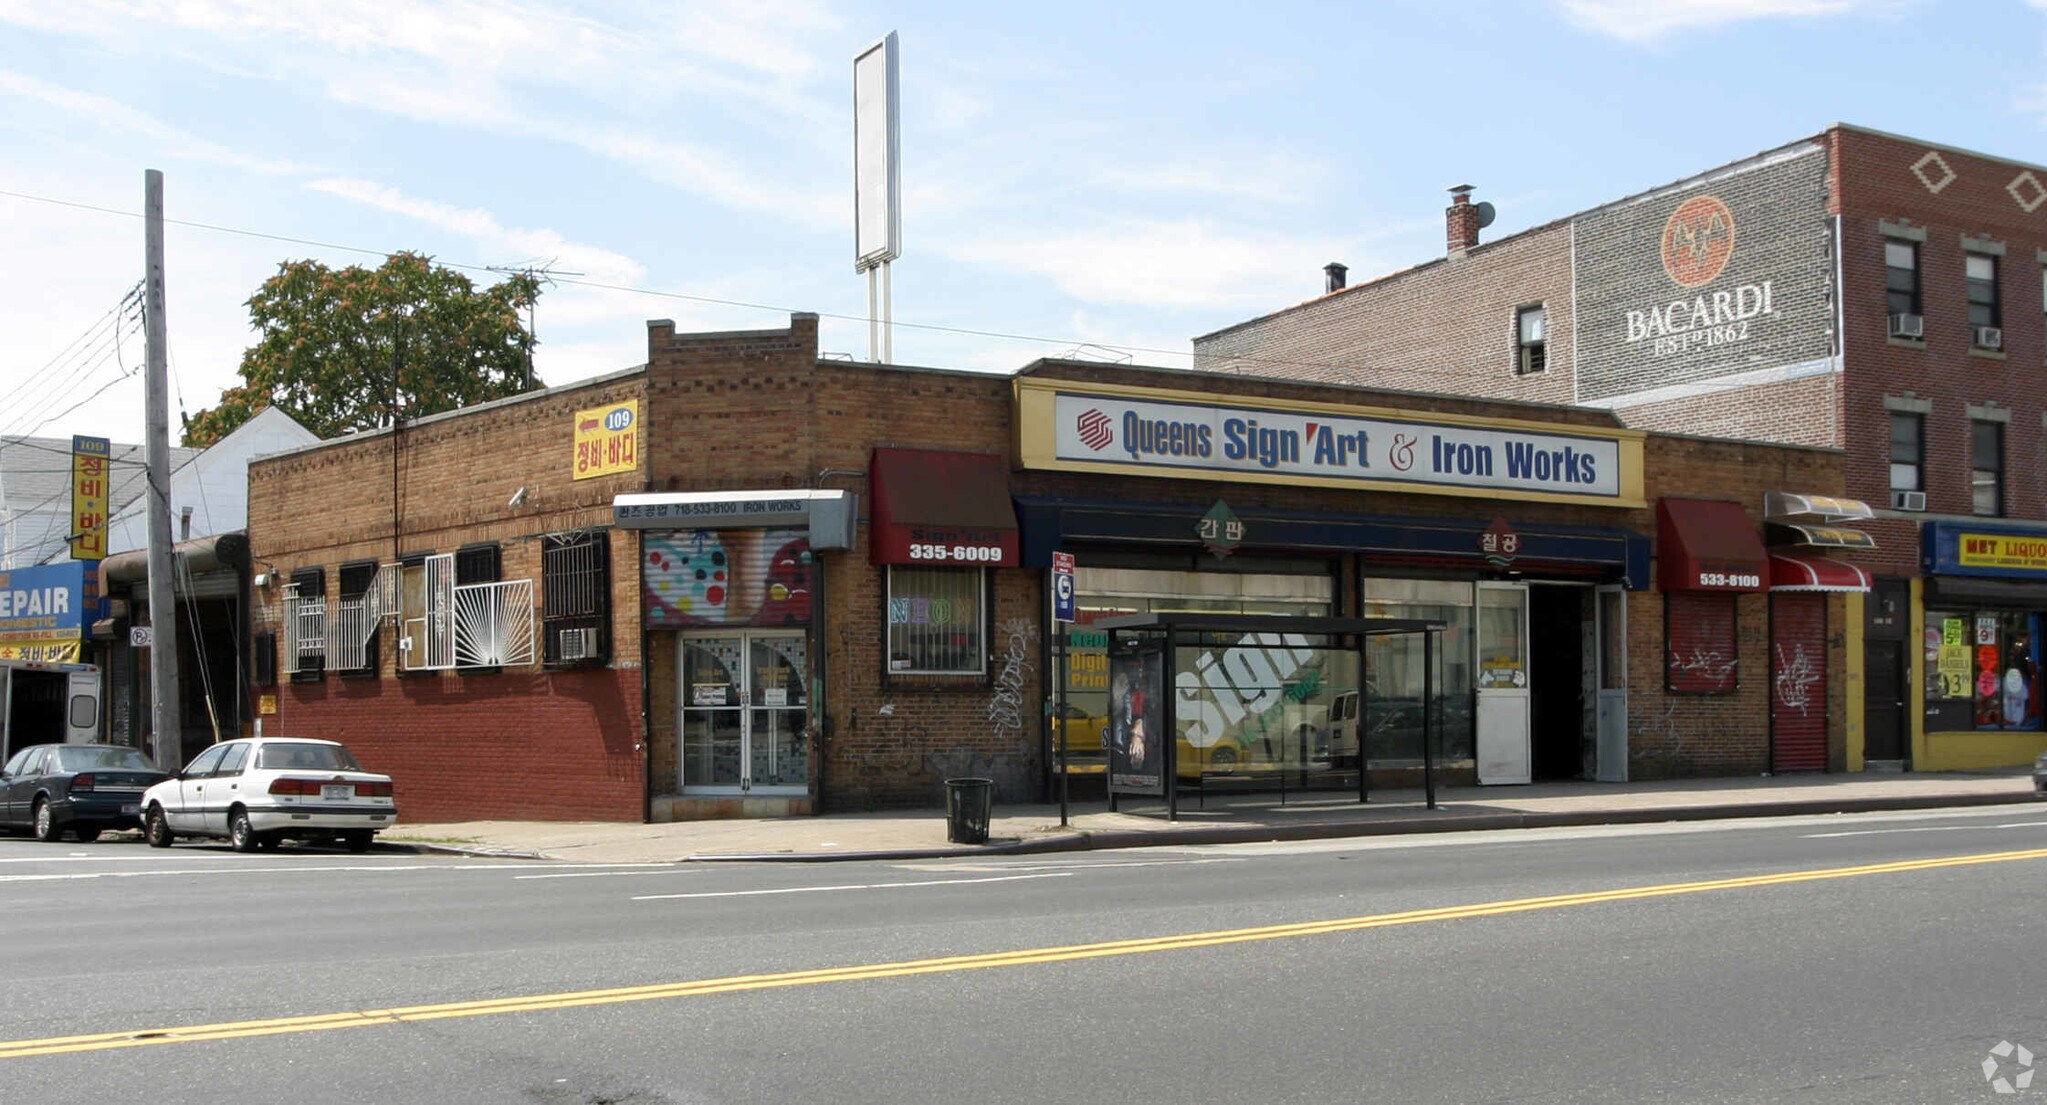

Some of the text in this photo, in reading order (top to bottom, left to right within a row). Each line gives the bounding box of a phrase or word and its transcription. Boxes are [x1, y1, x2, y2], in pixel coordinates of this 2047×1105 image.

[1626, 281, 1773, 342] BACARDI
[1706, 321, 1749, 347] 1862
[608, 410, 630, 429] 109
[80, 440, 105, 452] 109
[1122, 410, 1212, 460] Queens
[1223, 418, 1299, 468] Sign
[1389, 433, 1418, 471] &
[1432, 435, 1493, 476] Iron
[1505, 441, 1596, 484] Works
[674, 503, 737, 515] 718-533-8100
[743, 502, 766, 512] IRON
[769, 501, 802, 512] WORKS
[909, 544, 1003, 562] 335-6009
[1966, 539, 1998, 555] MET
[1700, 573, 1760, 588] 533-8100
[890, 597, 975, 624] NEON
[1176, 633, 1314, 748] Sign
